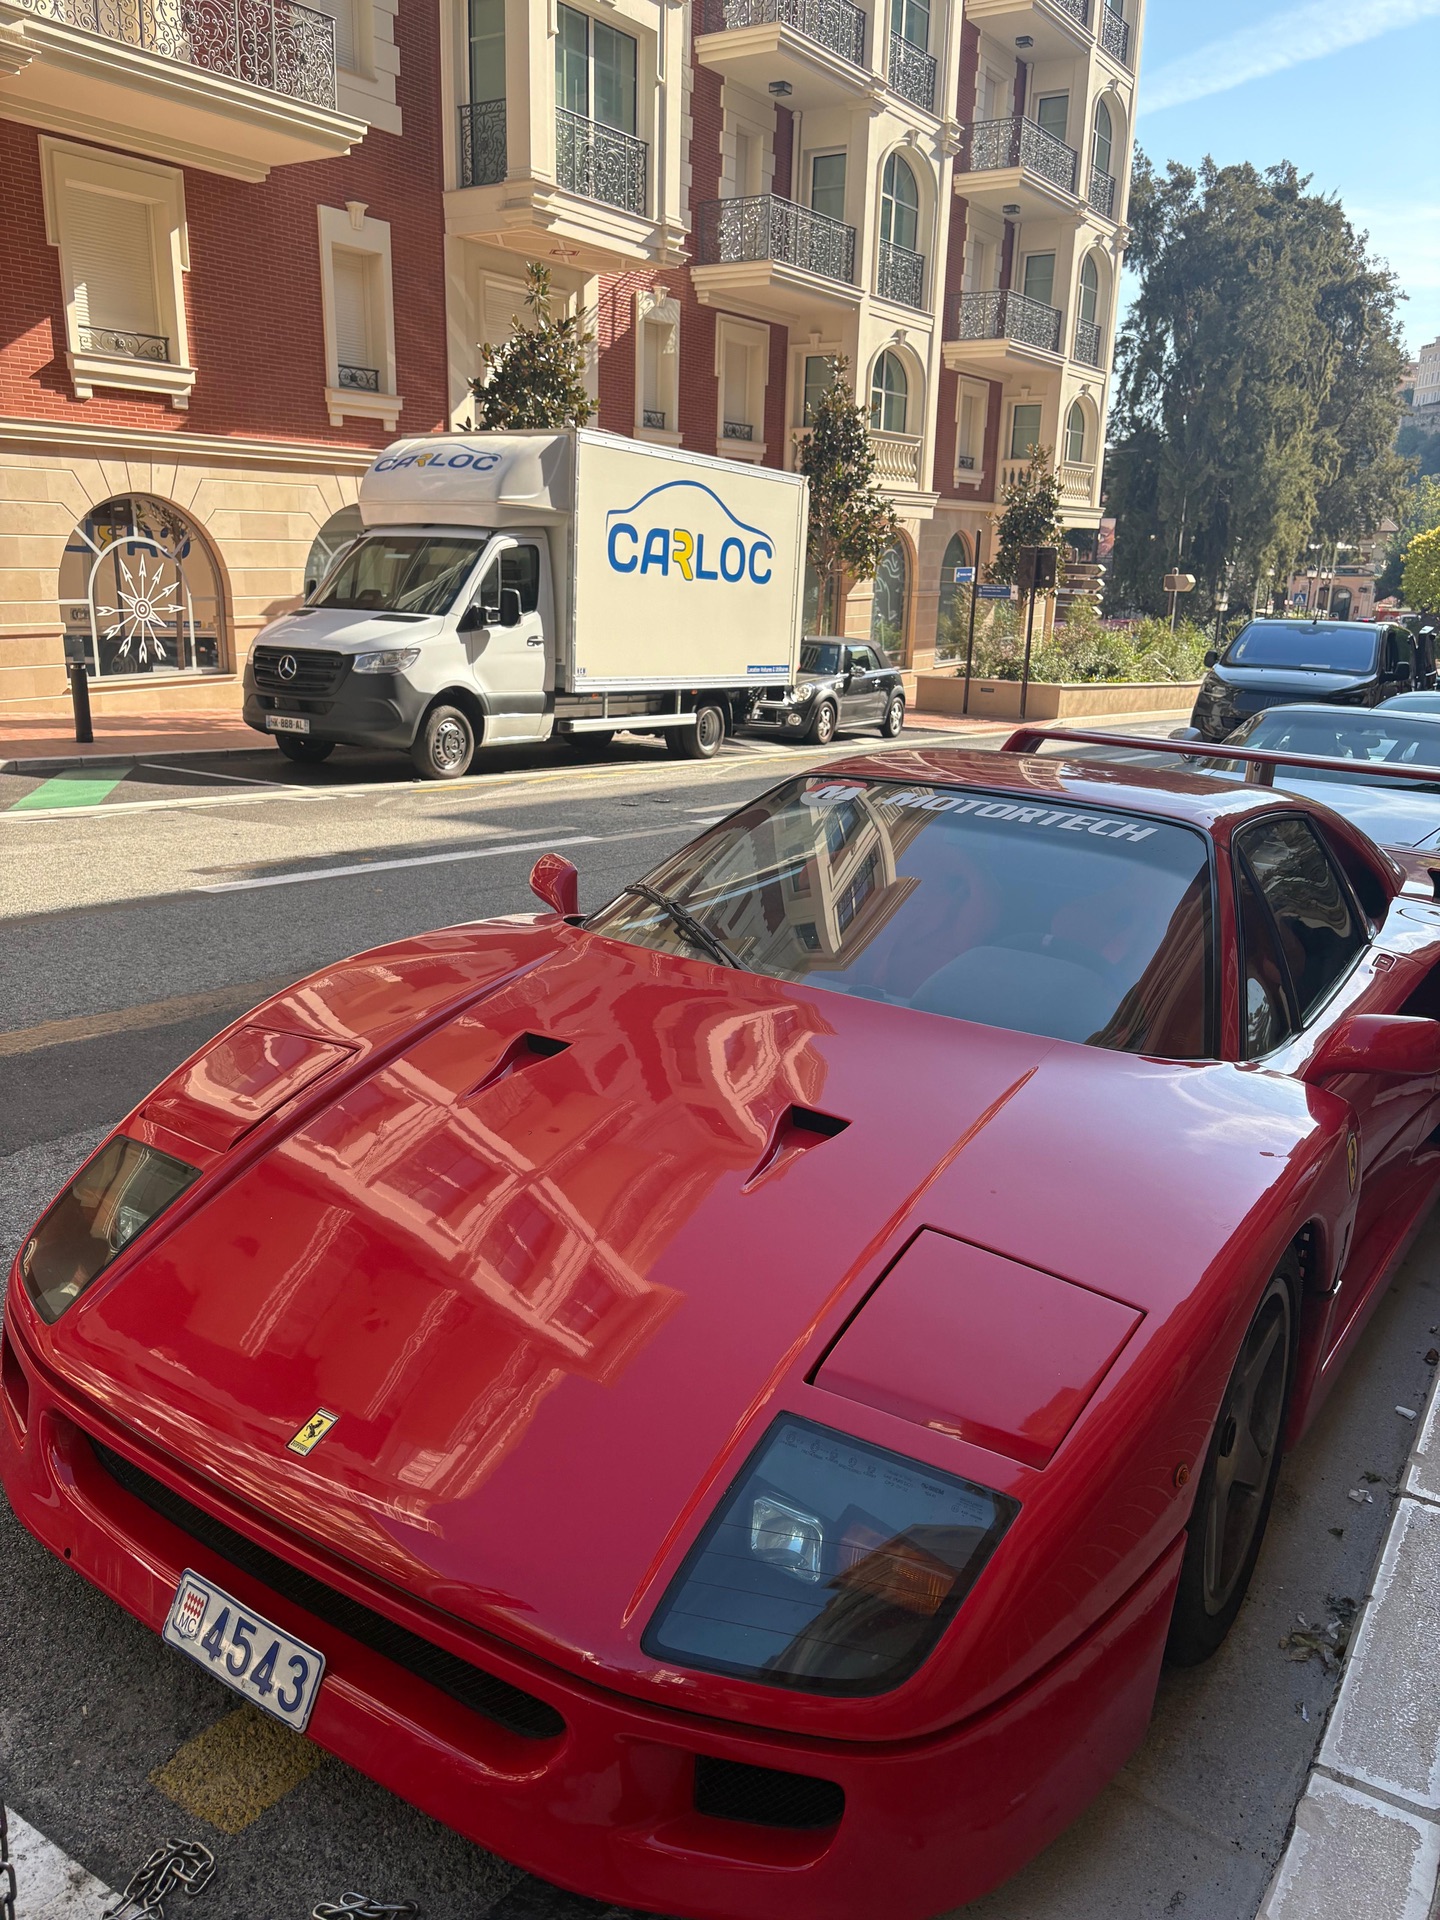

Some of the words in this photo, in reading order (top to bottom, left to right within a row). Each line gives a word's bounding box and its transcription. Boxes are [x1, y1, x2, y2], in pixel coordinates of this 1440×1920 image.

[374, 452, 499, 473] CARLOC
[607, 523, 773, 585] CARLOC
[884, 792, 1160, 843] MOTORTECH
[178, 1611, 197, 1633] MC
[201, 1606, 309, 1713] 4543
